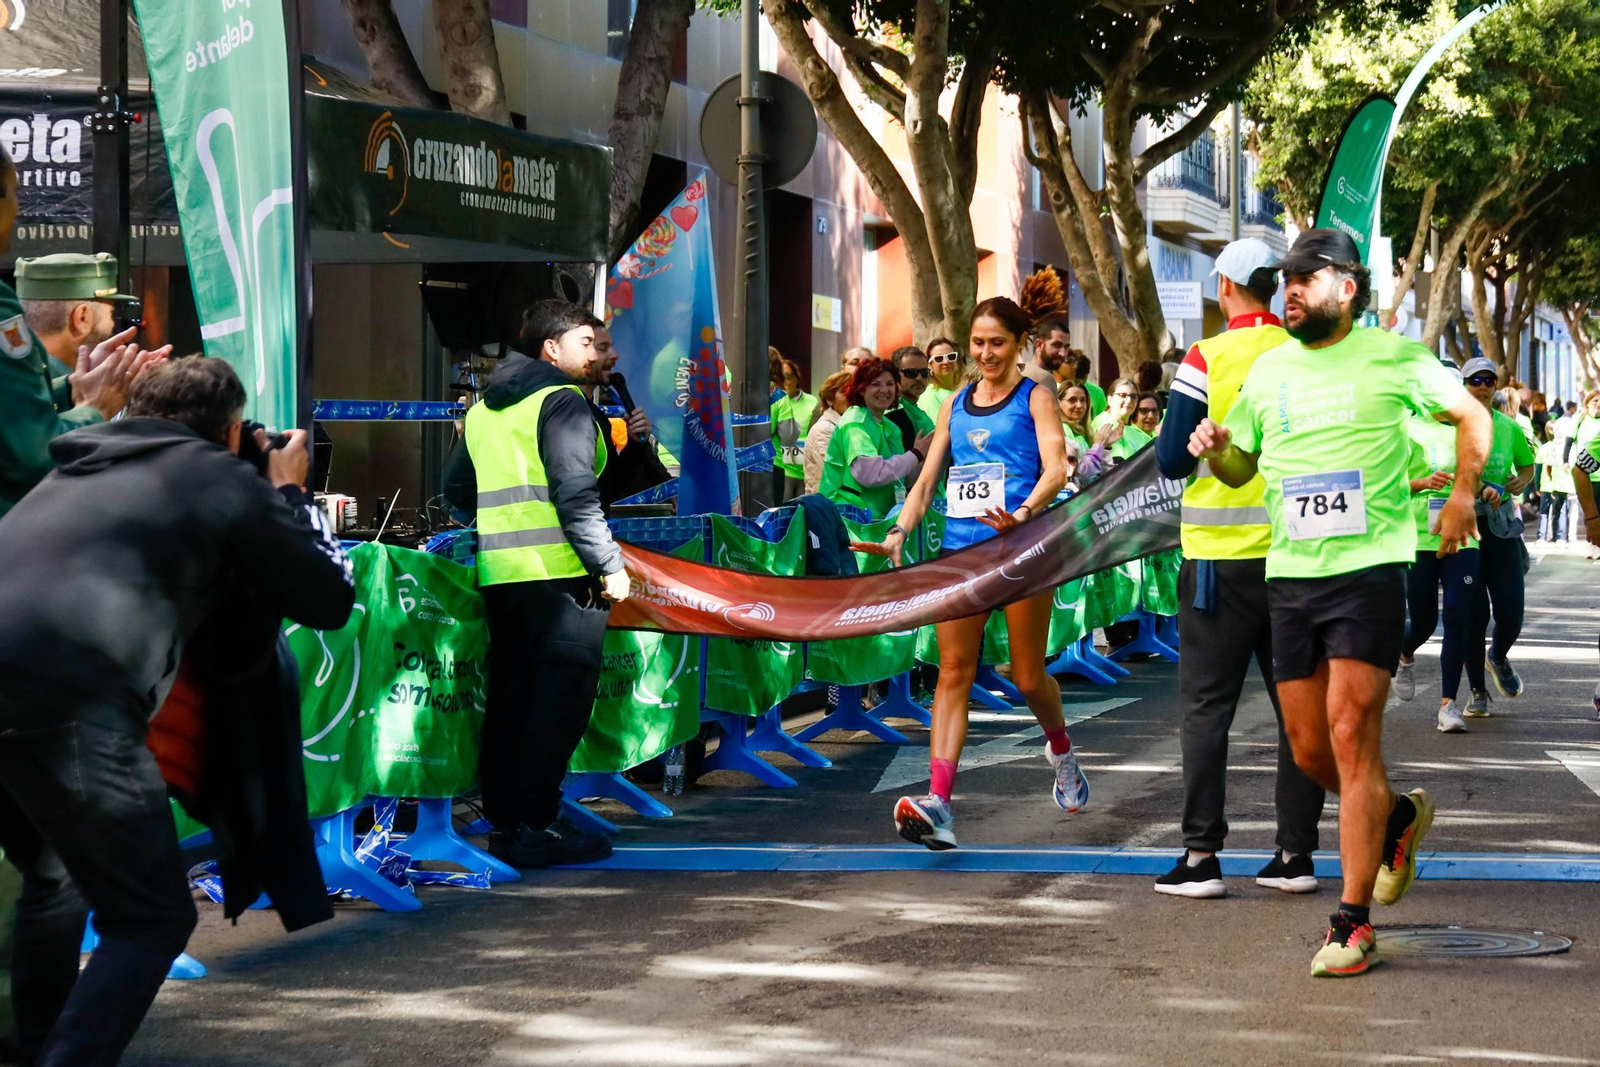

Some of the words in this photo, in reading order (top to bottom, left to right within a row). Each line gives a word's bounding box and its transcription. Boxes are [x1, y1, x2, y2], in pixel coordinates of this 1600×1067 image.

[0, 113, 81, 163] eta
[518, 199, 556, 221] deportivo
[1329, 209, 1364, 243] Tenemos
[1157, 245, 1193, 281] ABANCA
[1294, 408, 1358, 432] cáncer
[957, 481, 990, 500] 183
[1296, 492, 1348, 517] 784
